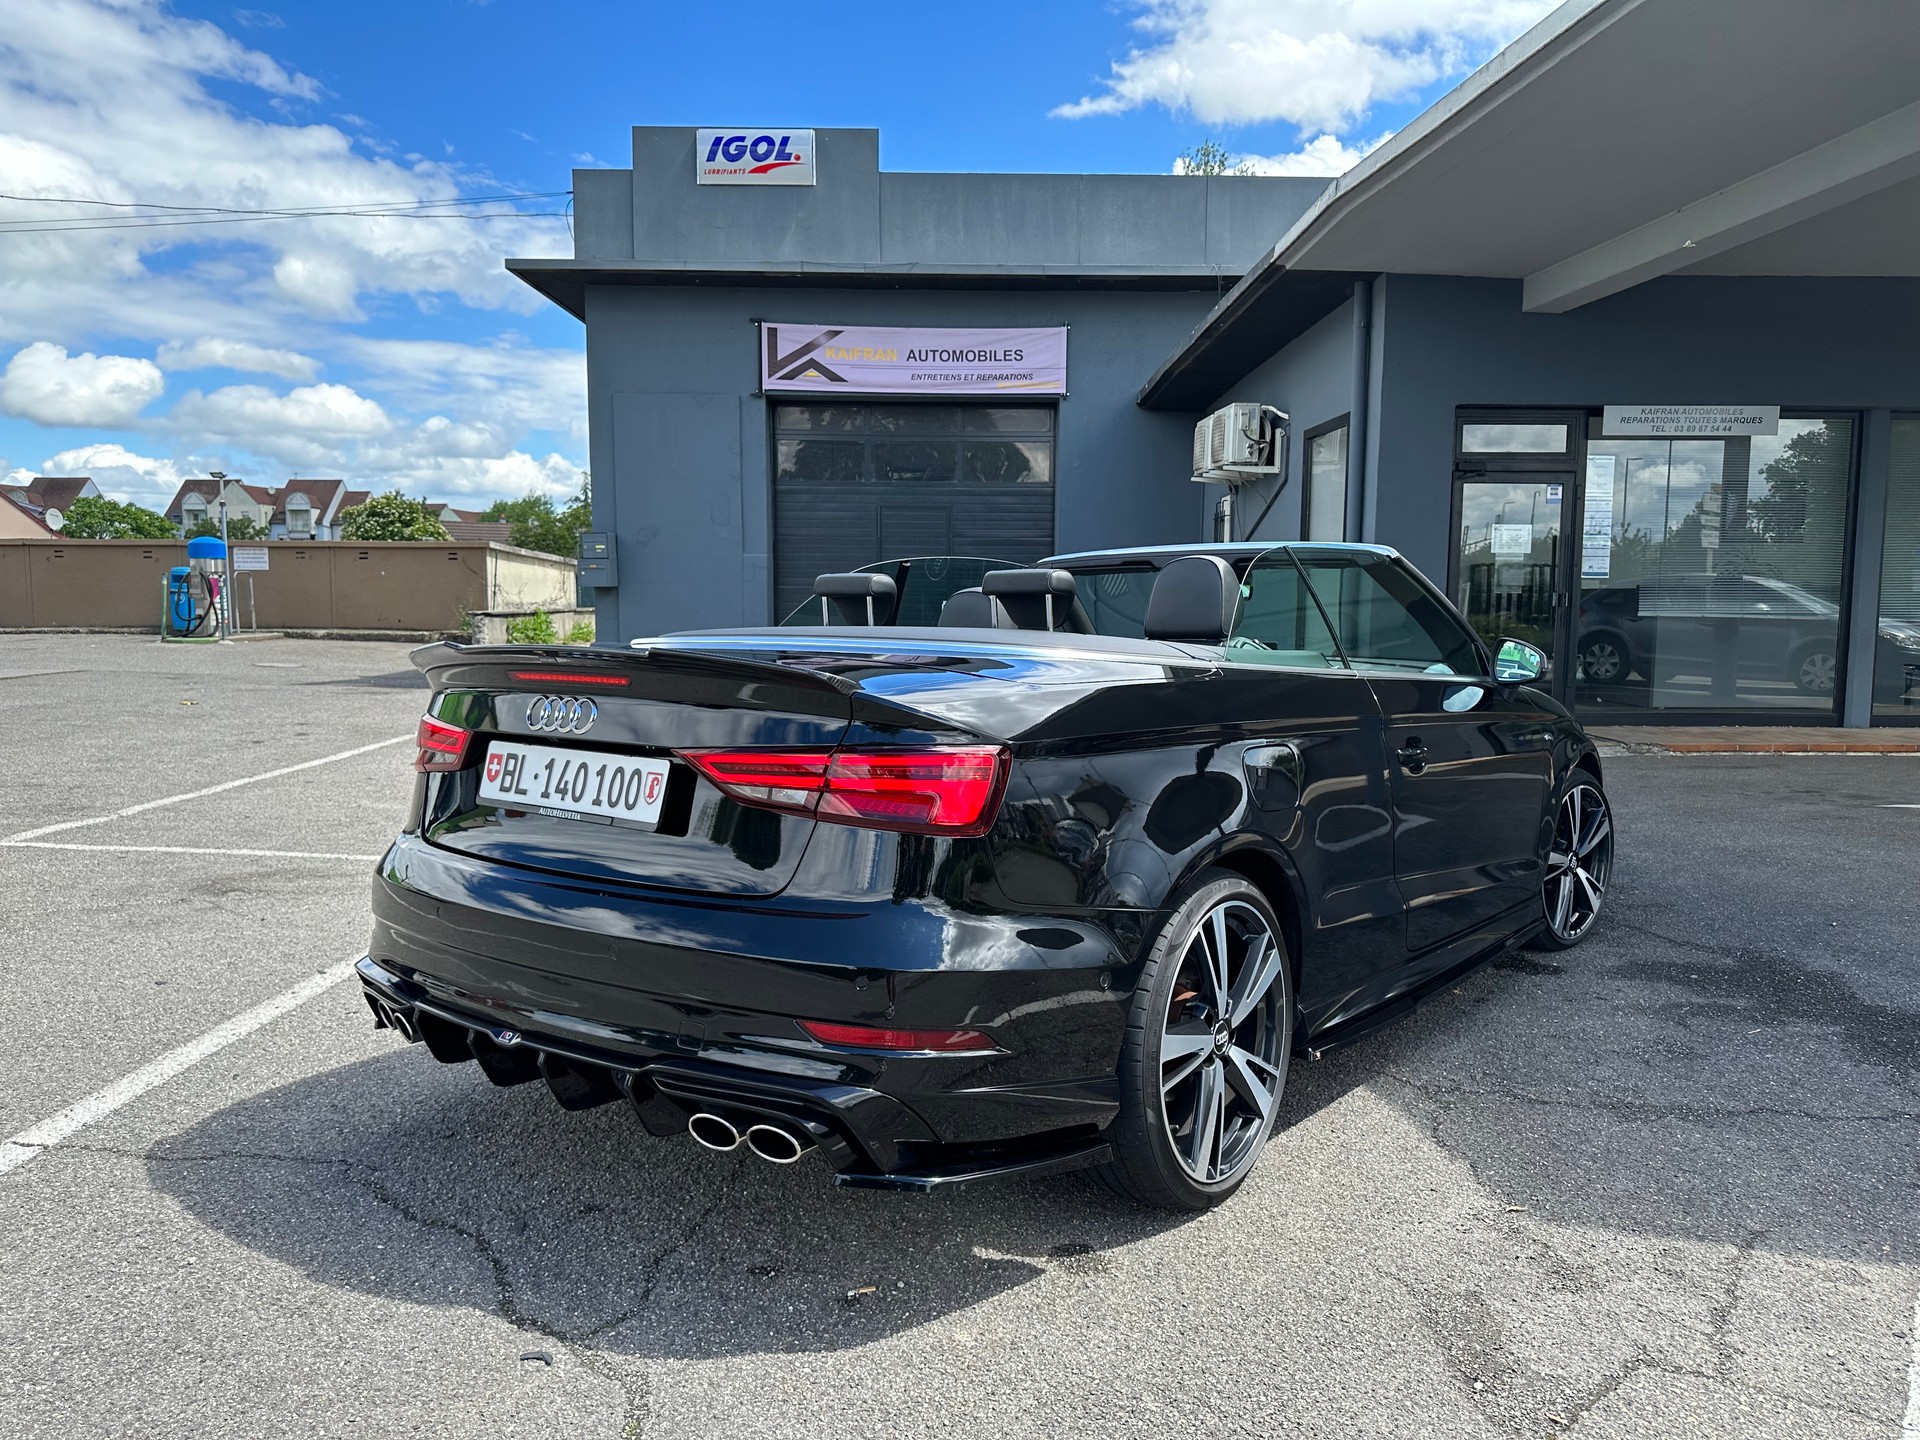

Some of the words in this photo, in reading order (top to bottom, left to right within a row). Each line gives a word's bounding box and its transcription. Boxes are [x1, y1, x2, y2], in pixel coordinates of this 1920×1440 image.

[825, 346, 897, 361] KAIFRAN
[906, 349, 1024, 362] AUTOMOBILES
[911, 373, 962, 381] ENTRETIENS
[964, 373, 975, 381] ET
[976, 373, 1034, 381] REPARATIONS
[1620, 416, 1681, 424] REPARATIONS
[1684, 416, 1718, 424] TOUTES
[1719, 416, 1764, 424] MARQUES
